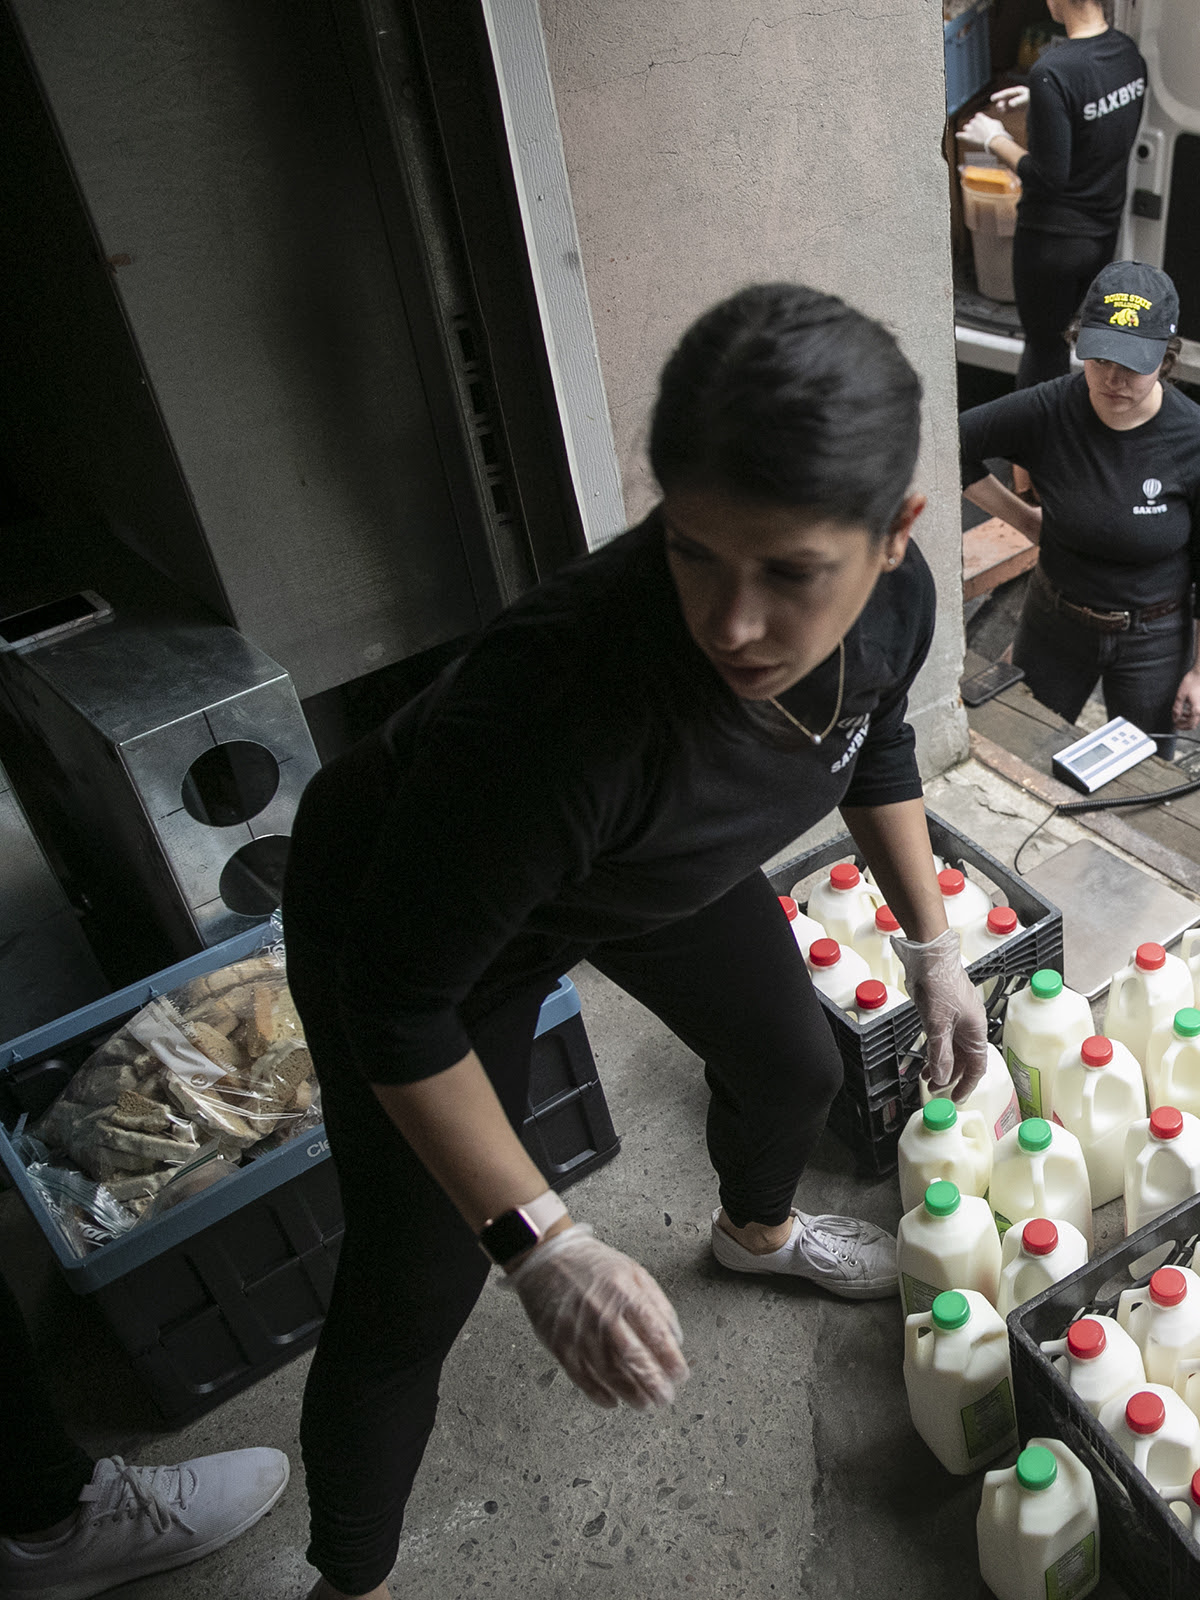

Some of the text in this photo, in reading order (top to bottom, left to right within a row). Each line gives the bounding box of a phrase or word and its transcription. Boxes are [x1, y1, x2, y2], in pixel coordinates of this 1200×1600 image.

[1083, 77, 1145, 121] SAXBYS
[1129, 295, 1153, 310] STATE
[1132, 503, 1168, 515] SAXBYS
[830, 723, 870, 774] SAXBY
[306, 1139, 330, 1157] Cle
